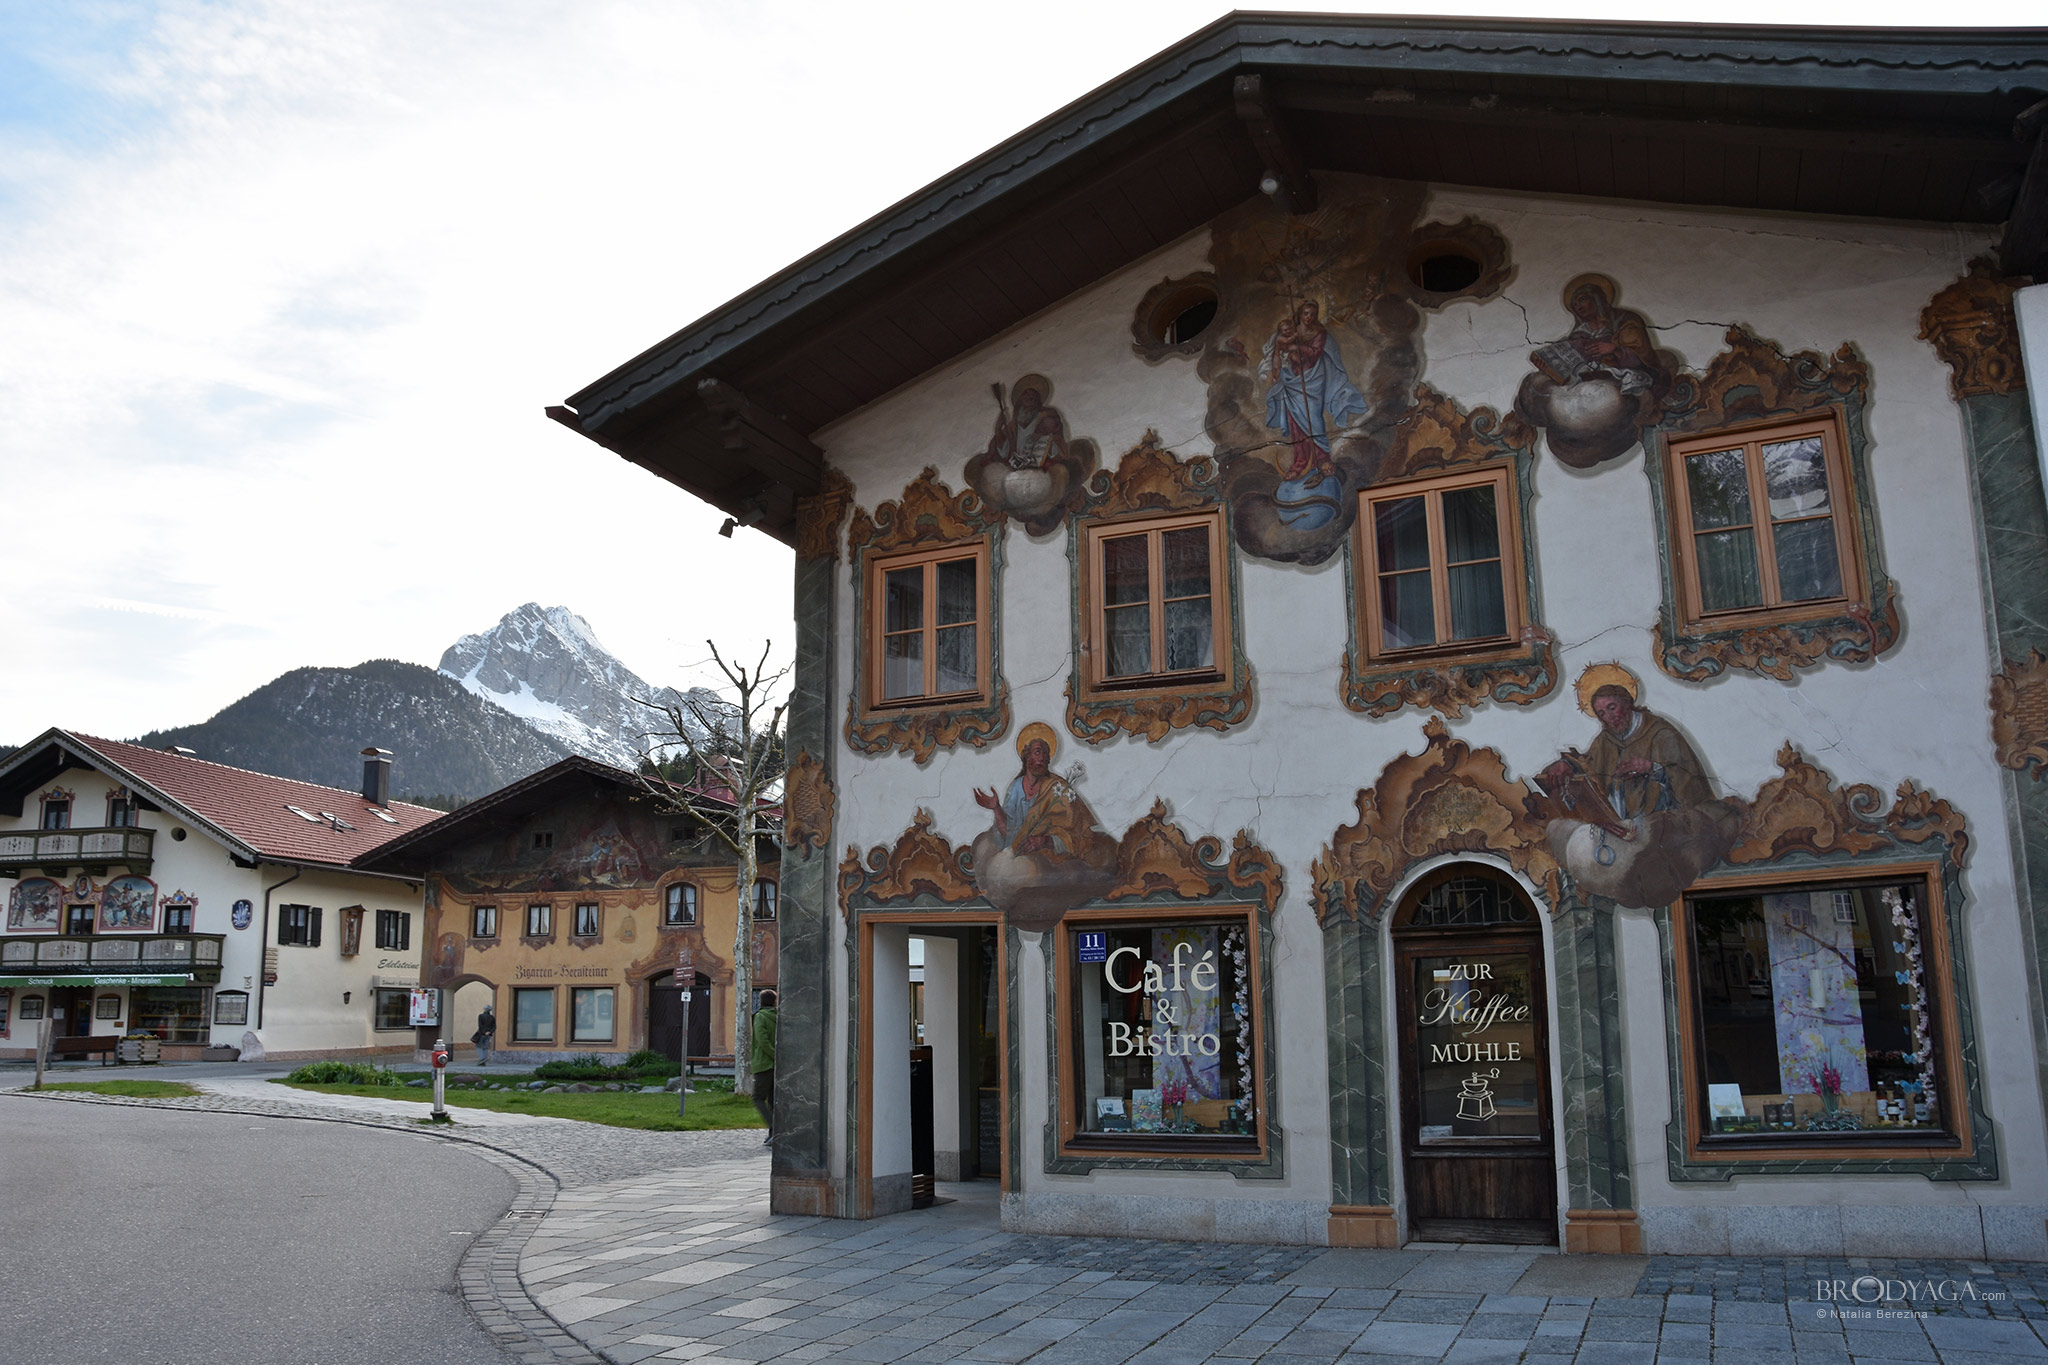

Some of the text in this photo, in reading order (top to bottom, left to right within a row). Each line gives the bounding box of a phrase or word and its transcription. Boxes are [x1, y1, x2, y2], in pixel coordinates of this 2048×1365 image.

[1085, 934, 1099, 948] 11
[377, 959, 420, 969] Edelsteine
[1104, 942, 1217, 994] Café
[1449, 963, 1494, 981] ZUR
[28, 977, 54, 985] Schmuck
[1156, 998, 1178, 1024] &
[1419, 987, 1530, 1037] Kaffee
[1108, 1021, 1221, 1057] Bistro
[1431, 1041, 1521, 1063] MÜHLE
